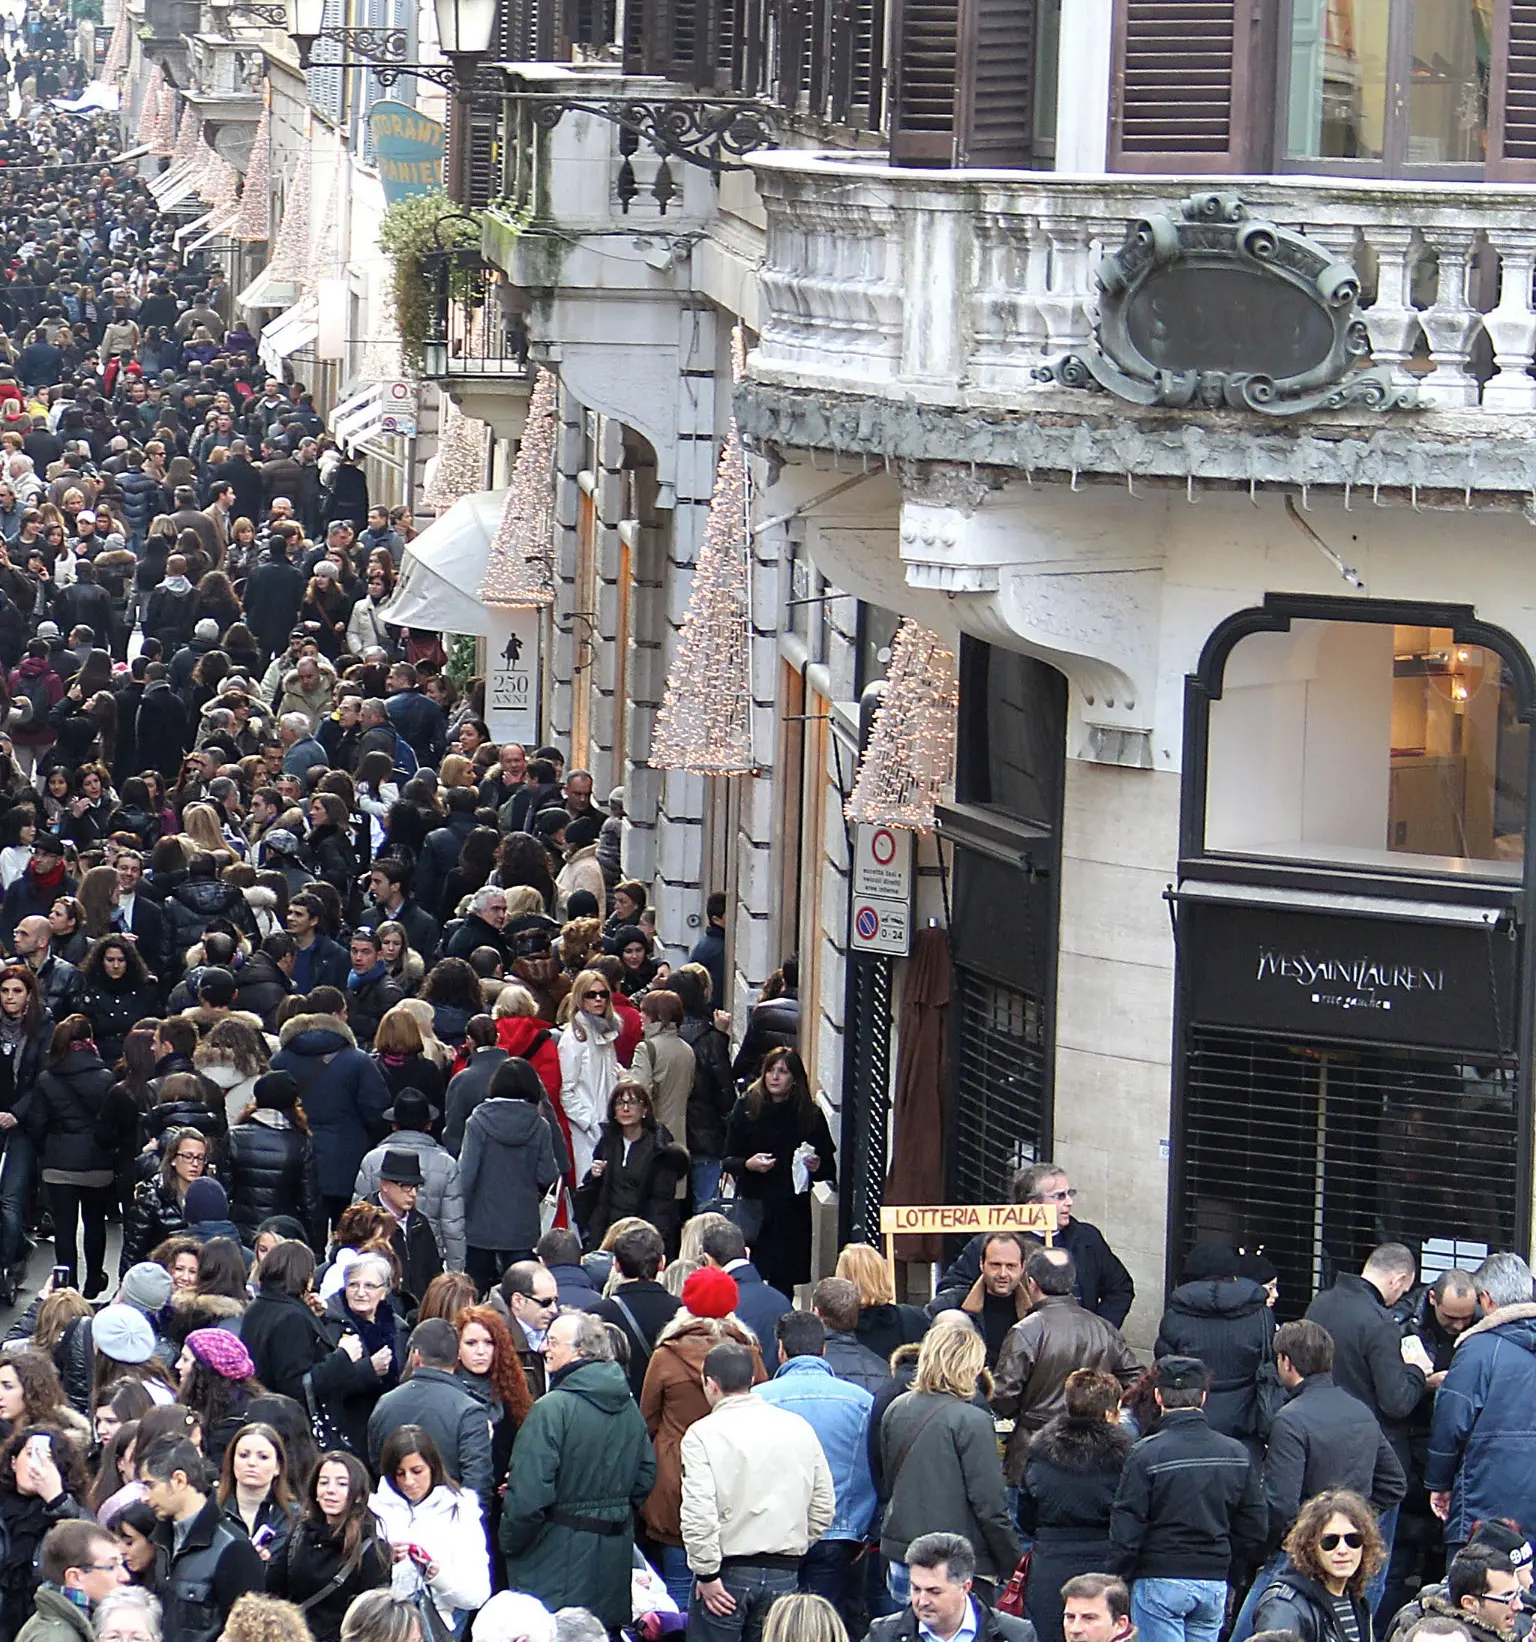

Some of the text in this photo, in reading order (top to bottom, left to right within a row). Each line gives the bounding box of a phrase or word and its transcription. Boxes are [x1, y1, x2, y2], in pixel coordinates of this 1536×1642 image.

[493, 675, 529, 694] 250
[492, 694, 528, 704] ANNI
[895, 1205, 1048, 1229] LOTTERIA ITALIA
